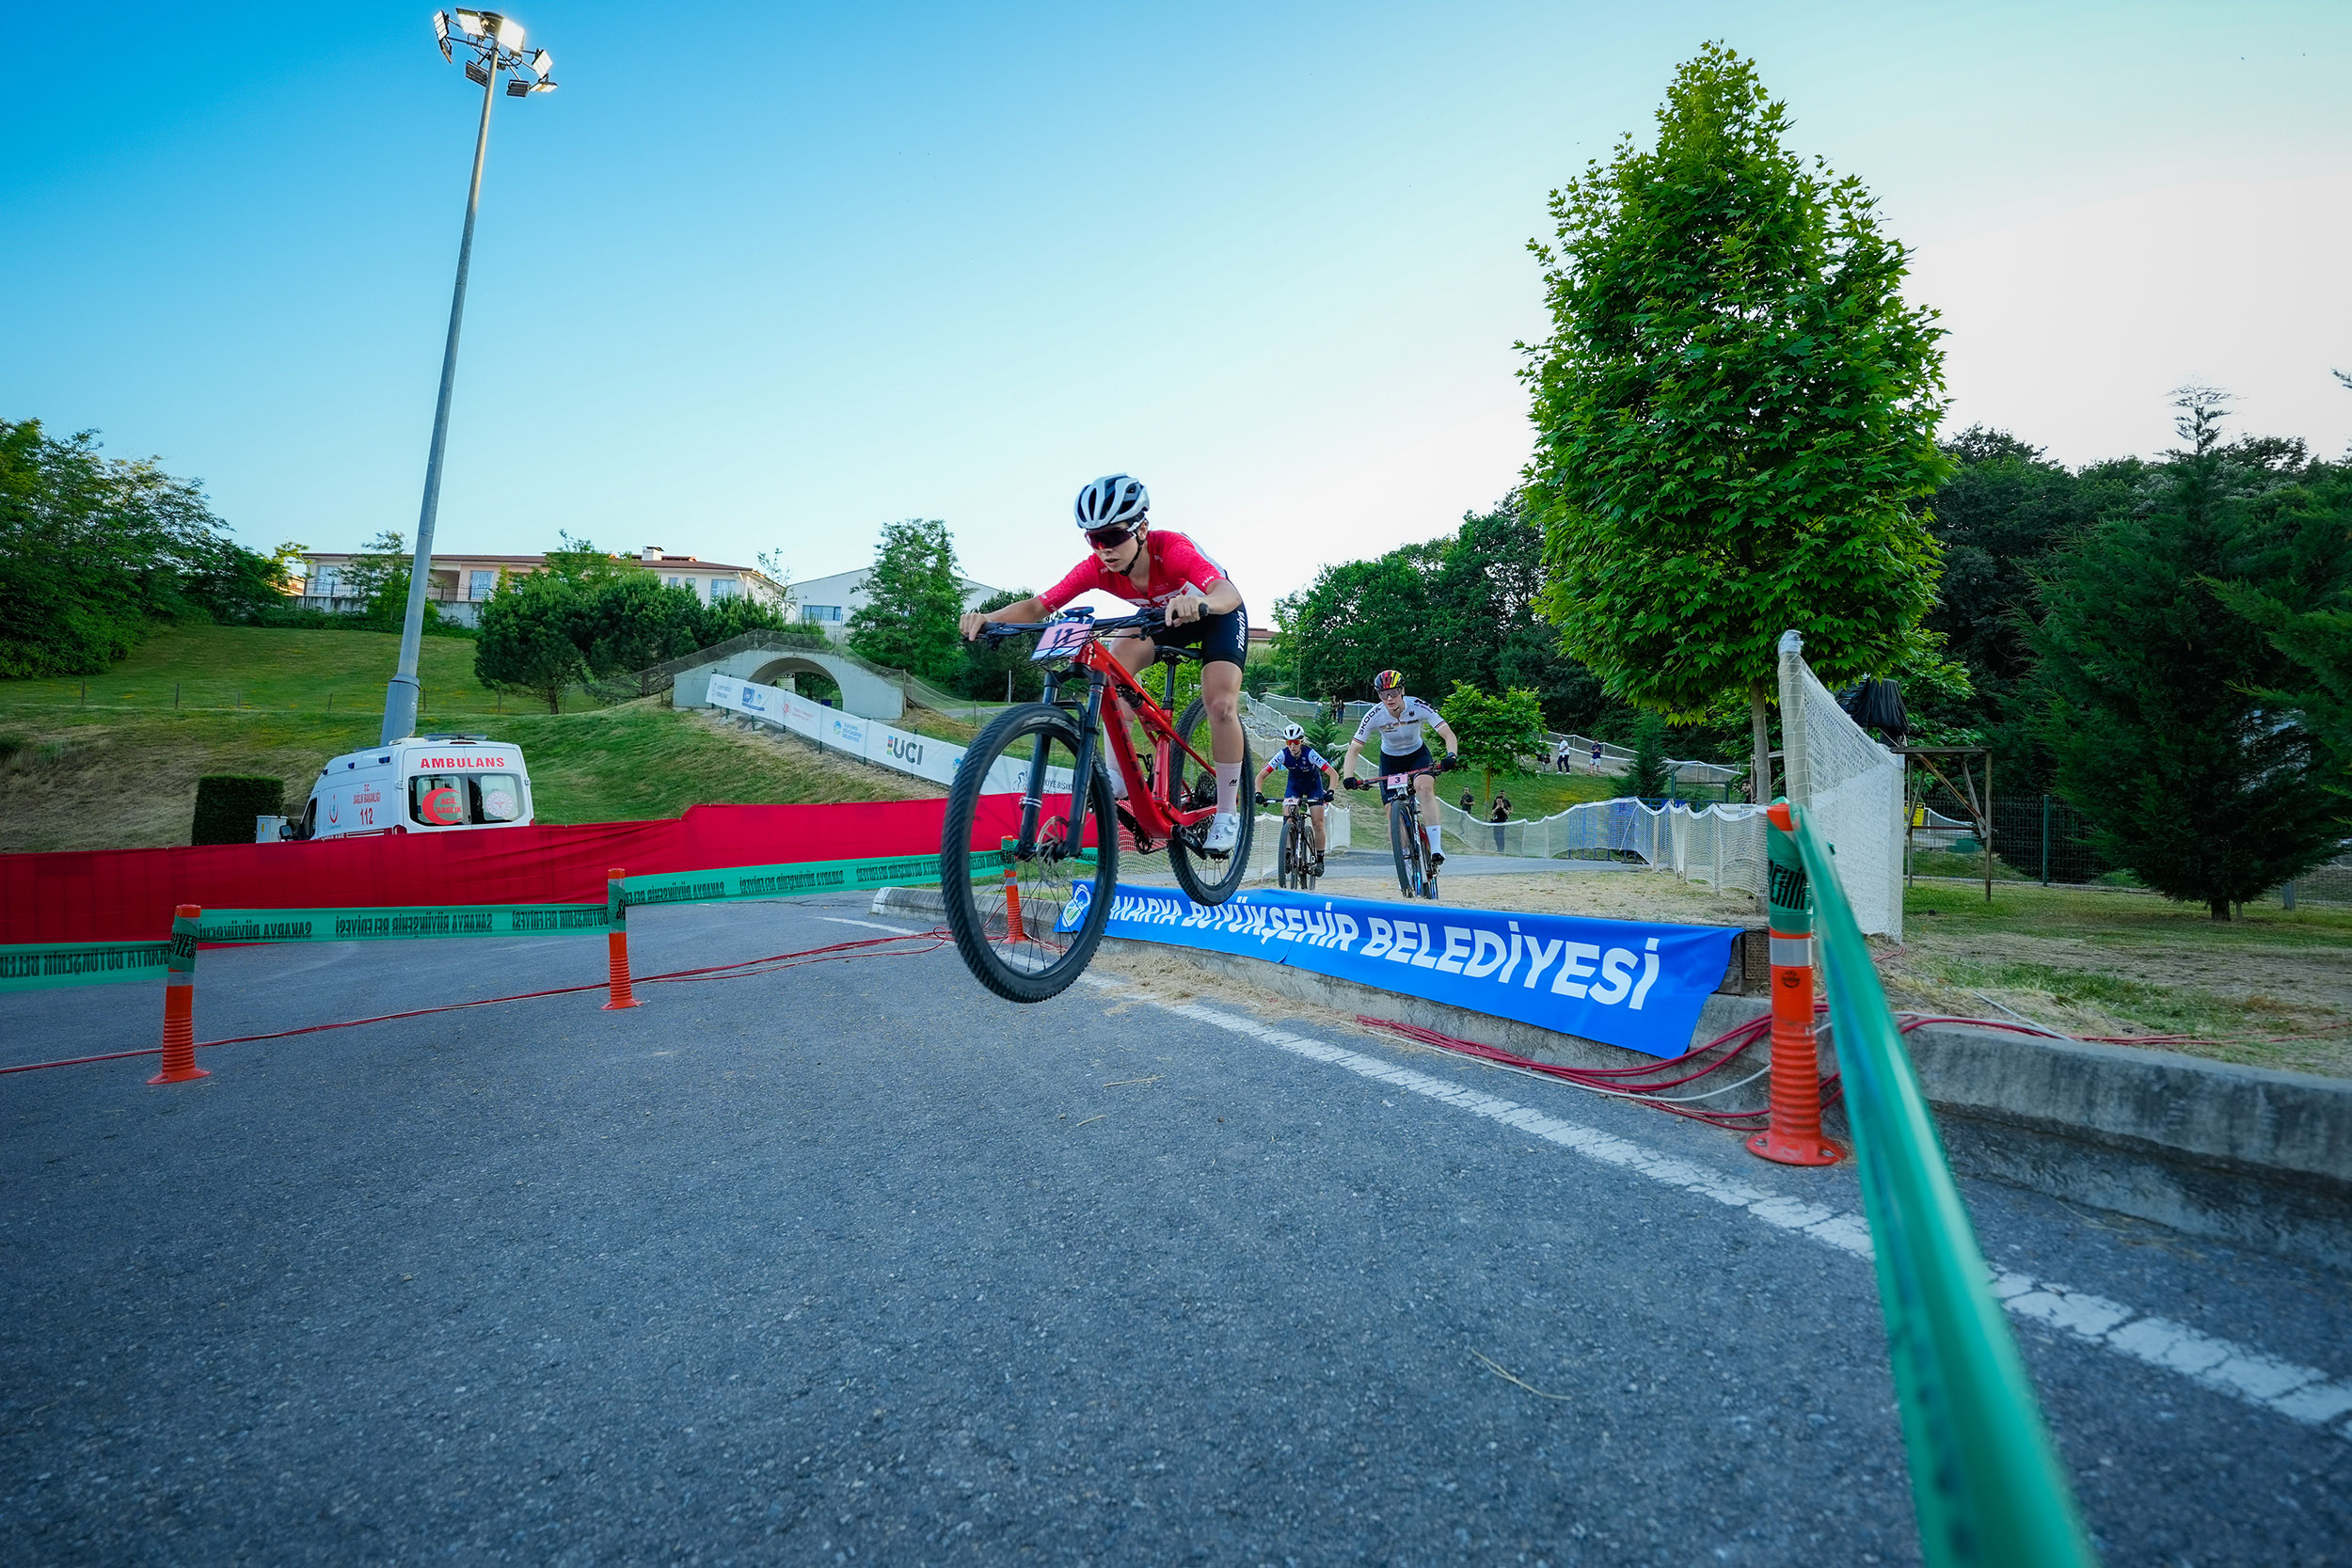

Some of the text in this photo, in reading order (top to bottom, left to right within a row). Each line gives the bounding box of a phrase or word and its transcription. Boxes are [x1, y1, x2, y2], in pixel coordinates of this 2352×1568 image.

[1053, 627, 1073, 645] 11
[893, 736, 924, 766] UCI
[421, 756, 505, 768] AMBULANS
[359, 807, 373, 825] 112
[1108, 895, 1661, 1011] AKARYA BÜYÜKŞEHİR BELEDİYESİ
